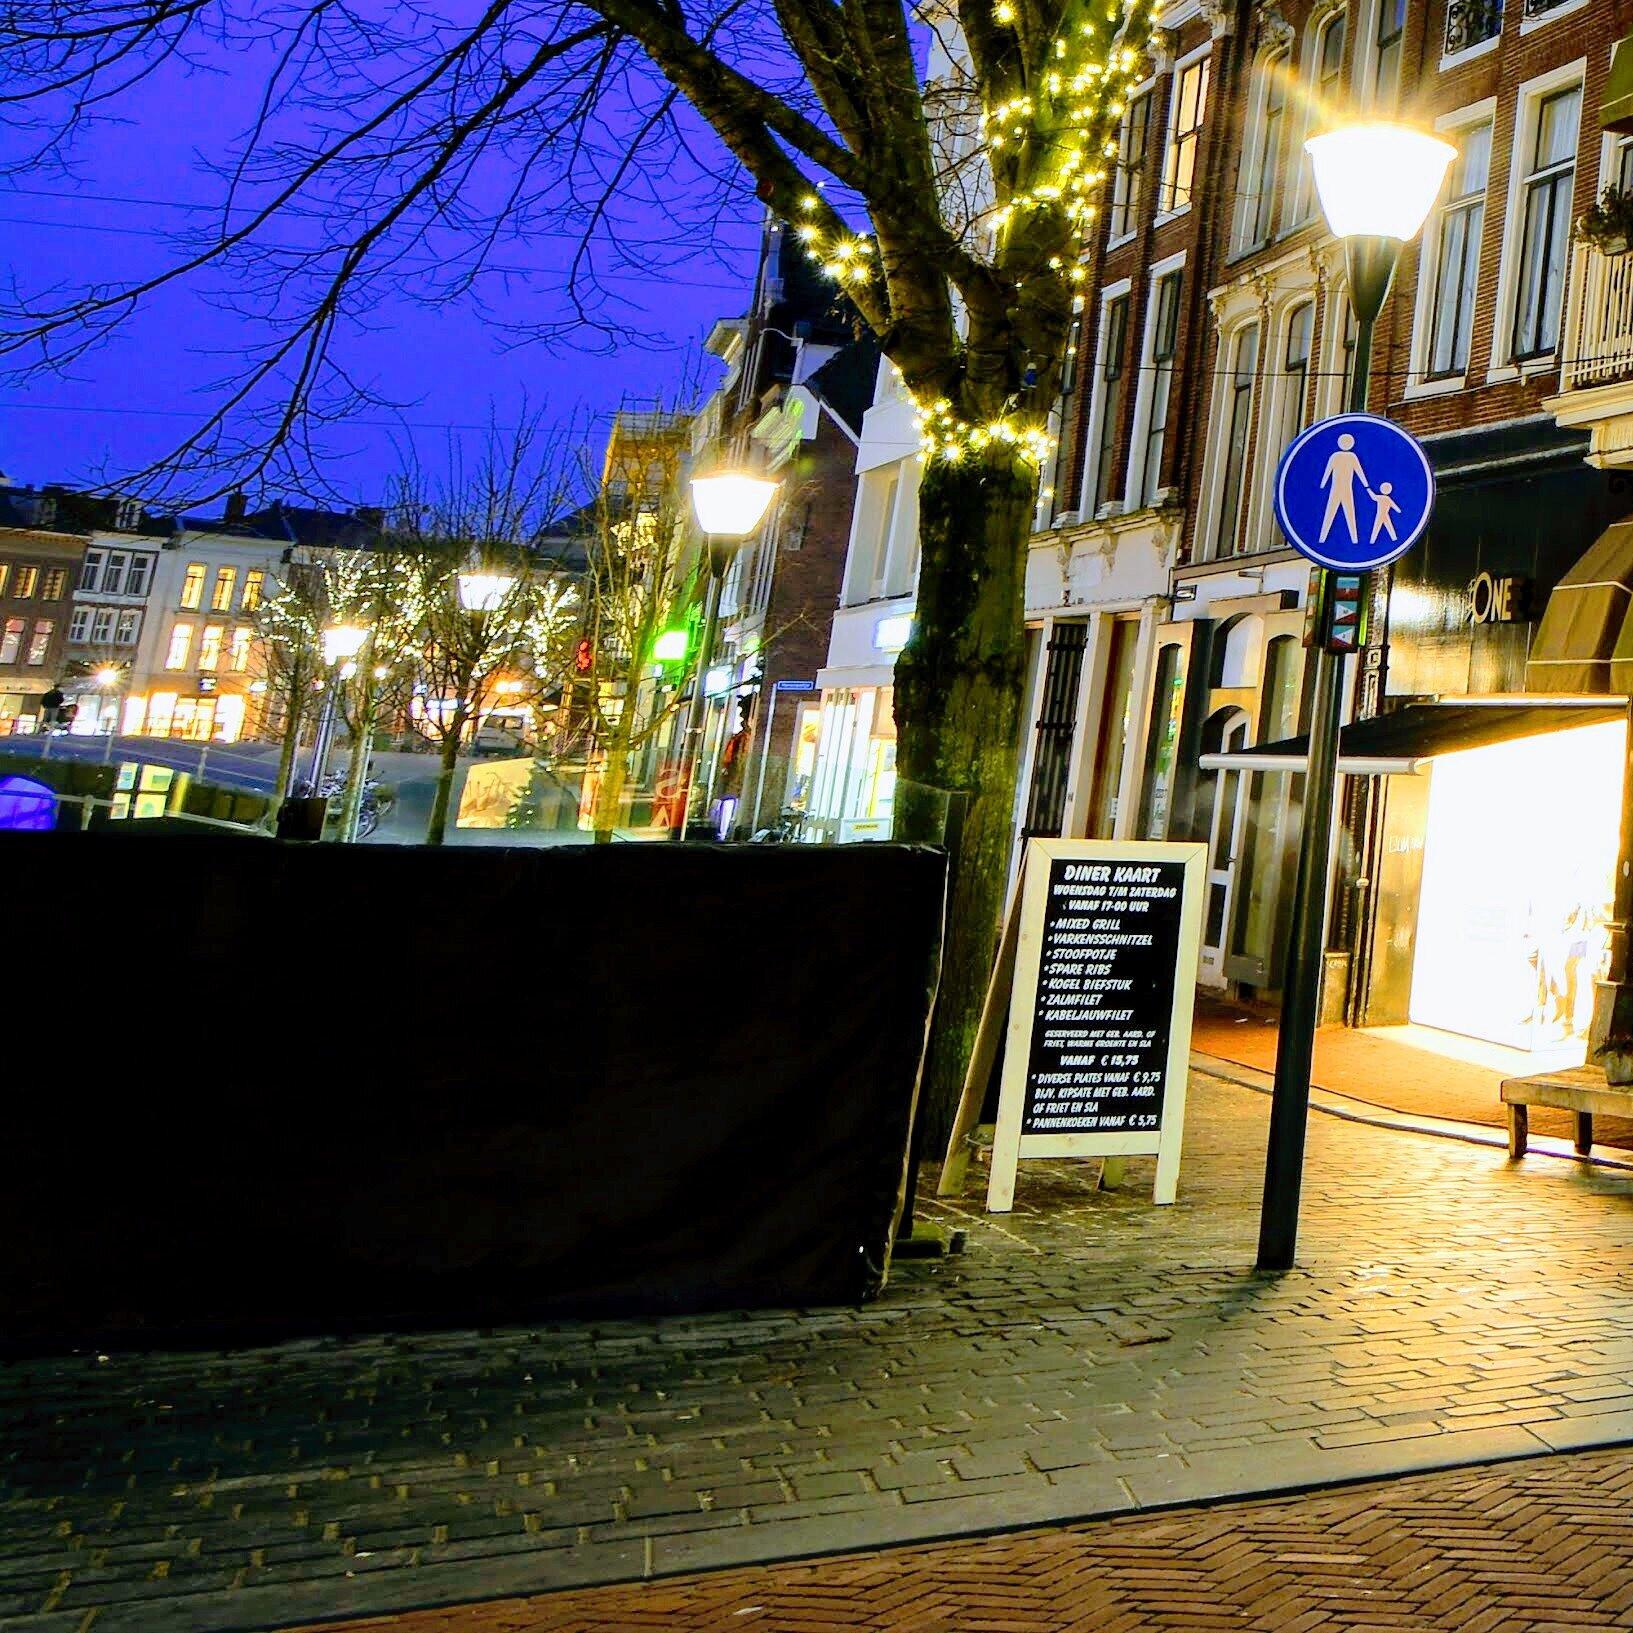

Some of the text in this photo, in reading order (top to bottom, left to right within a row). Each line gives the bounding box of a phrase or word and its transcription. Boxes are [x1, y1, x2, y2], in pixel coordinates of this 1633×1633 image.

[1063, 864, 1161, 883] DINER KAART
[1053, 884, 1106, 896] WOENSDAG
[1129, 886, 1177, 898] ZATERDAG
[1068, 900, 1100, 911] VANAF
[1129, 901, 1149, 912] UUR
[1055, 918, 1120, 930] MIXED GRILL
[1053, 933, 1153, 945] VARKENSSCHNITZEL
[1052, 948, 1117, 960] STOOFPOTJE
[1048, 963, 1112, 975] SPARE RIBS
[1048, 978, 1133, 990] KOGEL BIEFSTUK
[1046, 994, 1103, 1005] ZALMFILET
[1044, 1010, 1134, 1021] KABELJAUWFILET
[1060, 1054, 1140, 1067] VANAF € 15,75
[1037, 1073, 1073, 1084] DIVERSE
[1103, 1072, 1130, 1083] VANAF
[1133, 1071, 1141, 1082] €
[1142, 1071, 1161, 1083] 9,75
[1032, 1101, 1099, 1113] OF FRIET EN SLA
[1032, 1114, 1157, 1128] PANNENKOEKEN VANAF € 5,75
